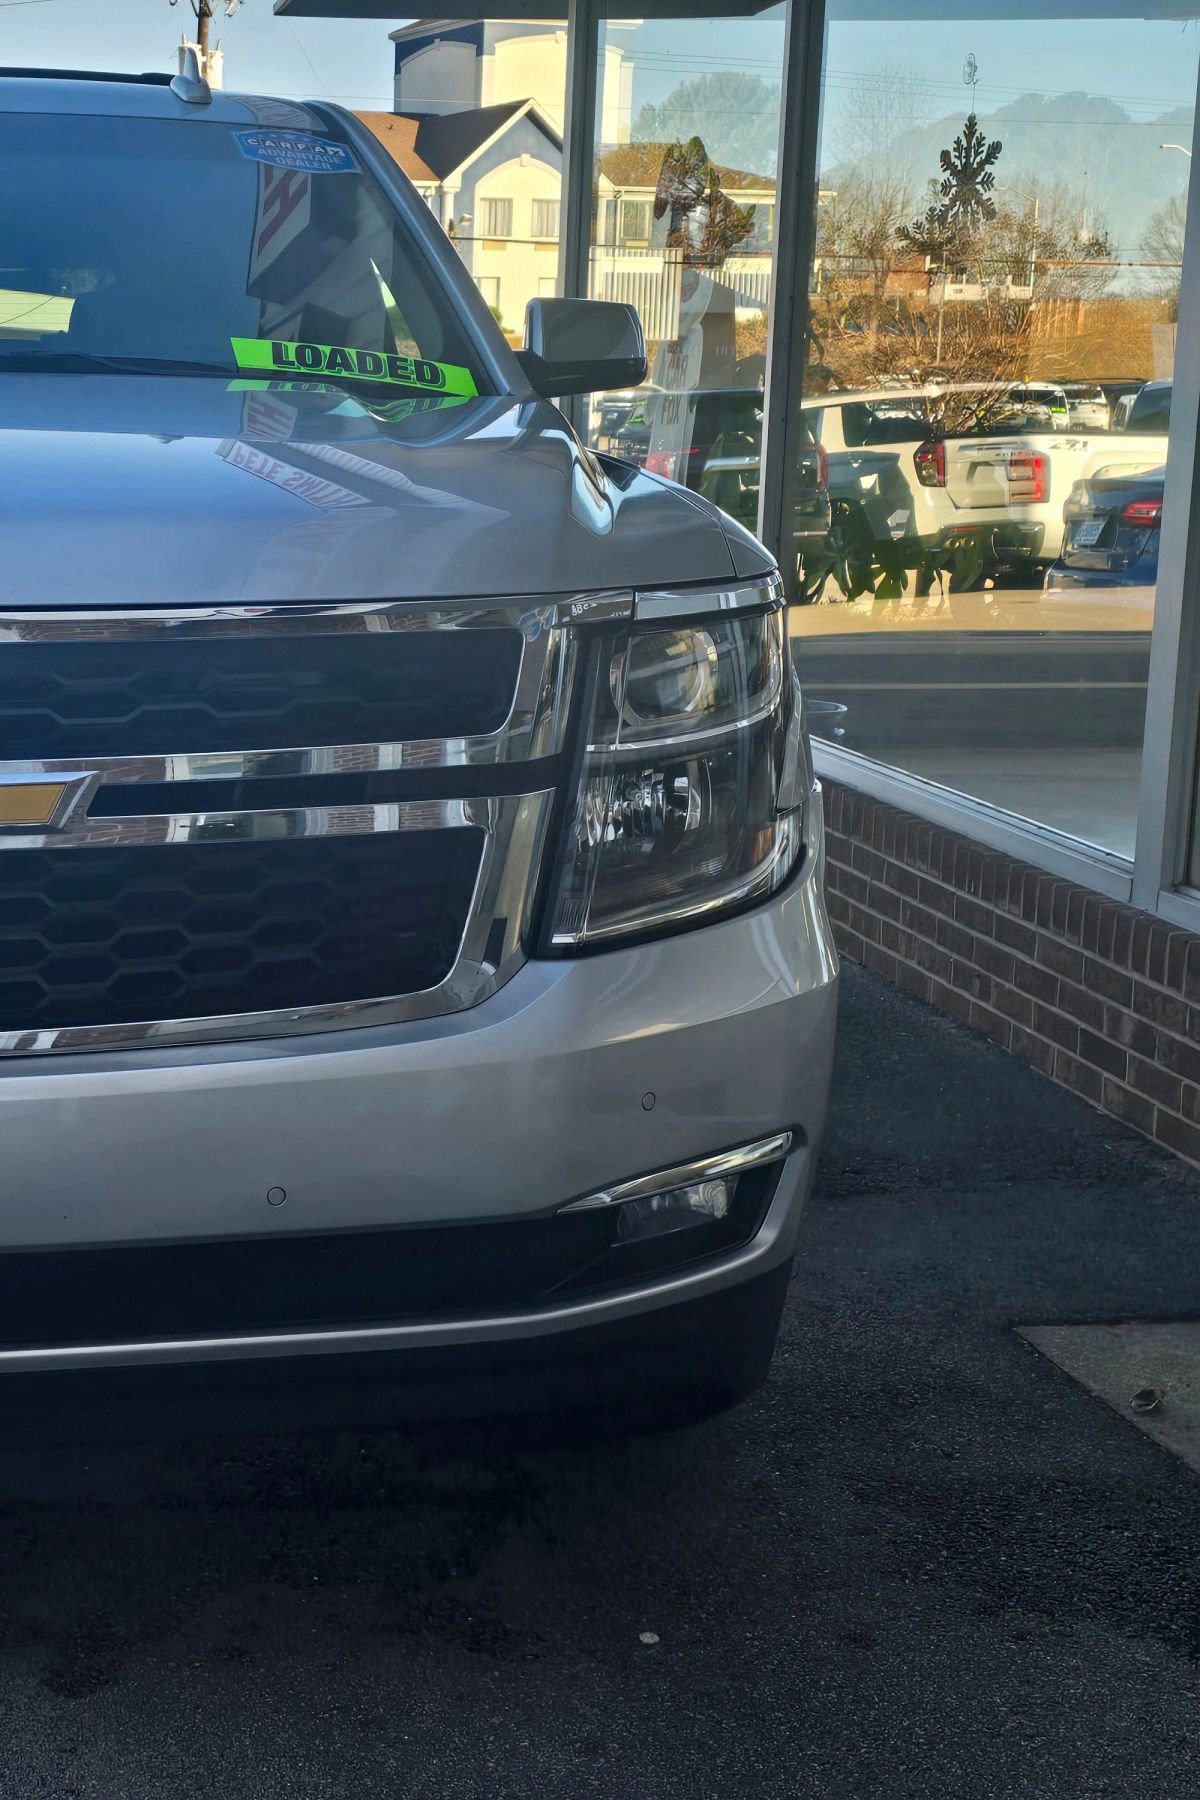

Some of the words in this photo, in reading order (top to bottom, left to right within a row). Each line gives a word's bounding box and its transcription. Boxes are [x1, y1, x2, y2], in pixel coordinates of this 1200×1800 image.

[247, 138, 346, 157] CARFAX
[257, 148, 342, 165] ADVANTAGE
[275, 156, 332, 170] DEALER
[271, 341, 447, 388] LOADED
